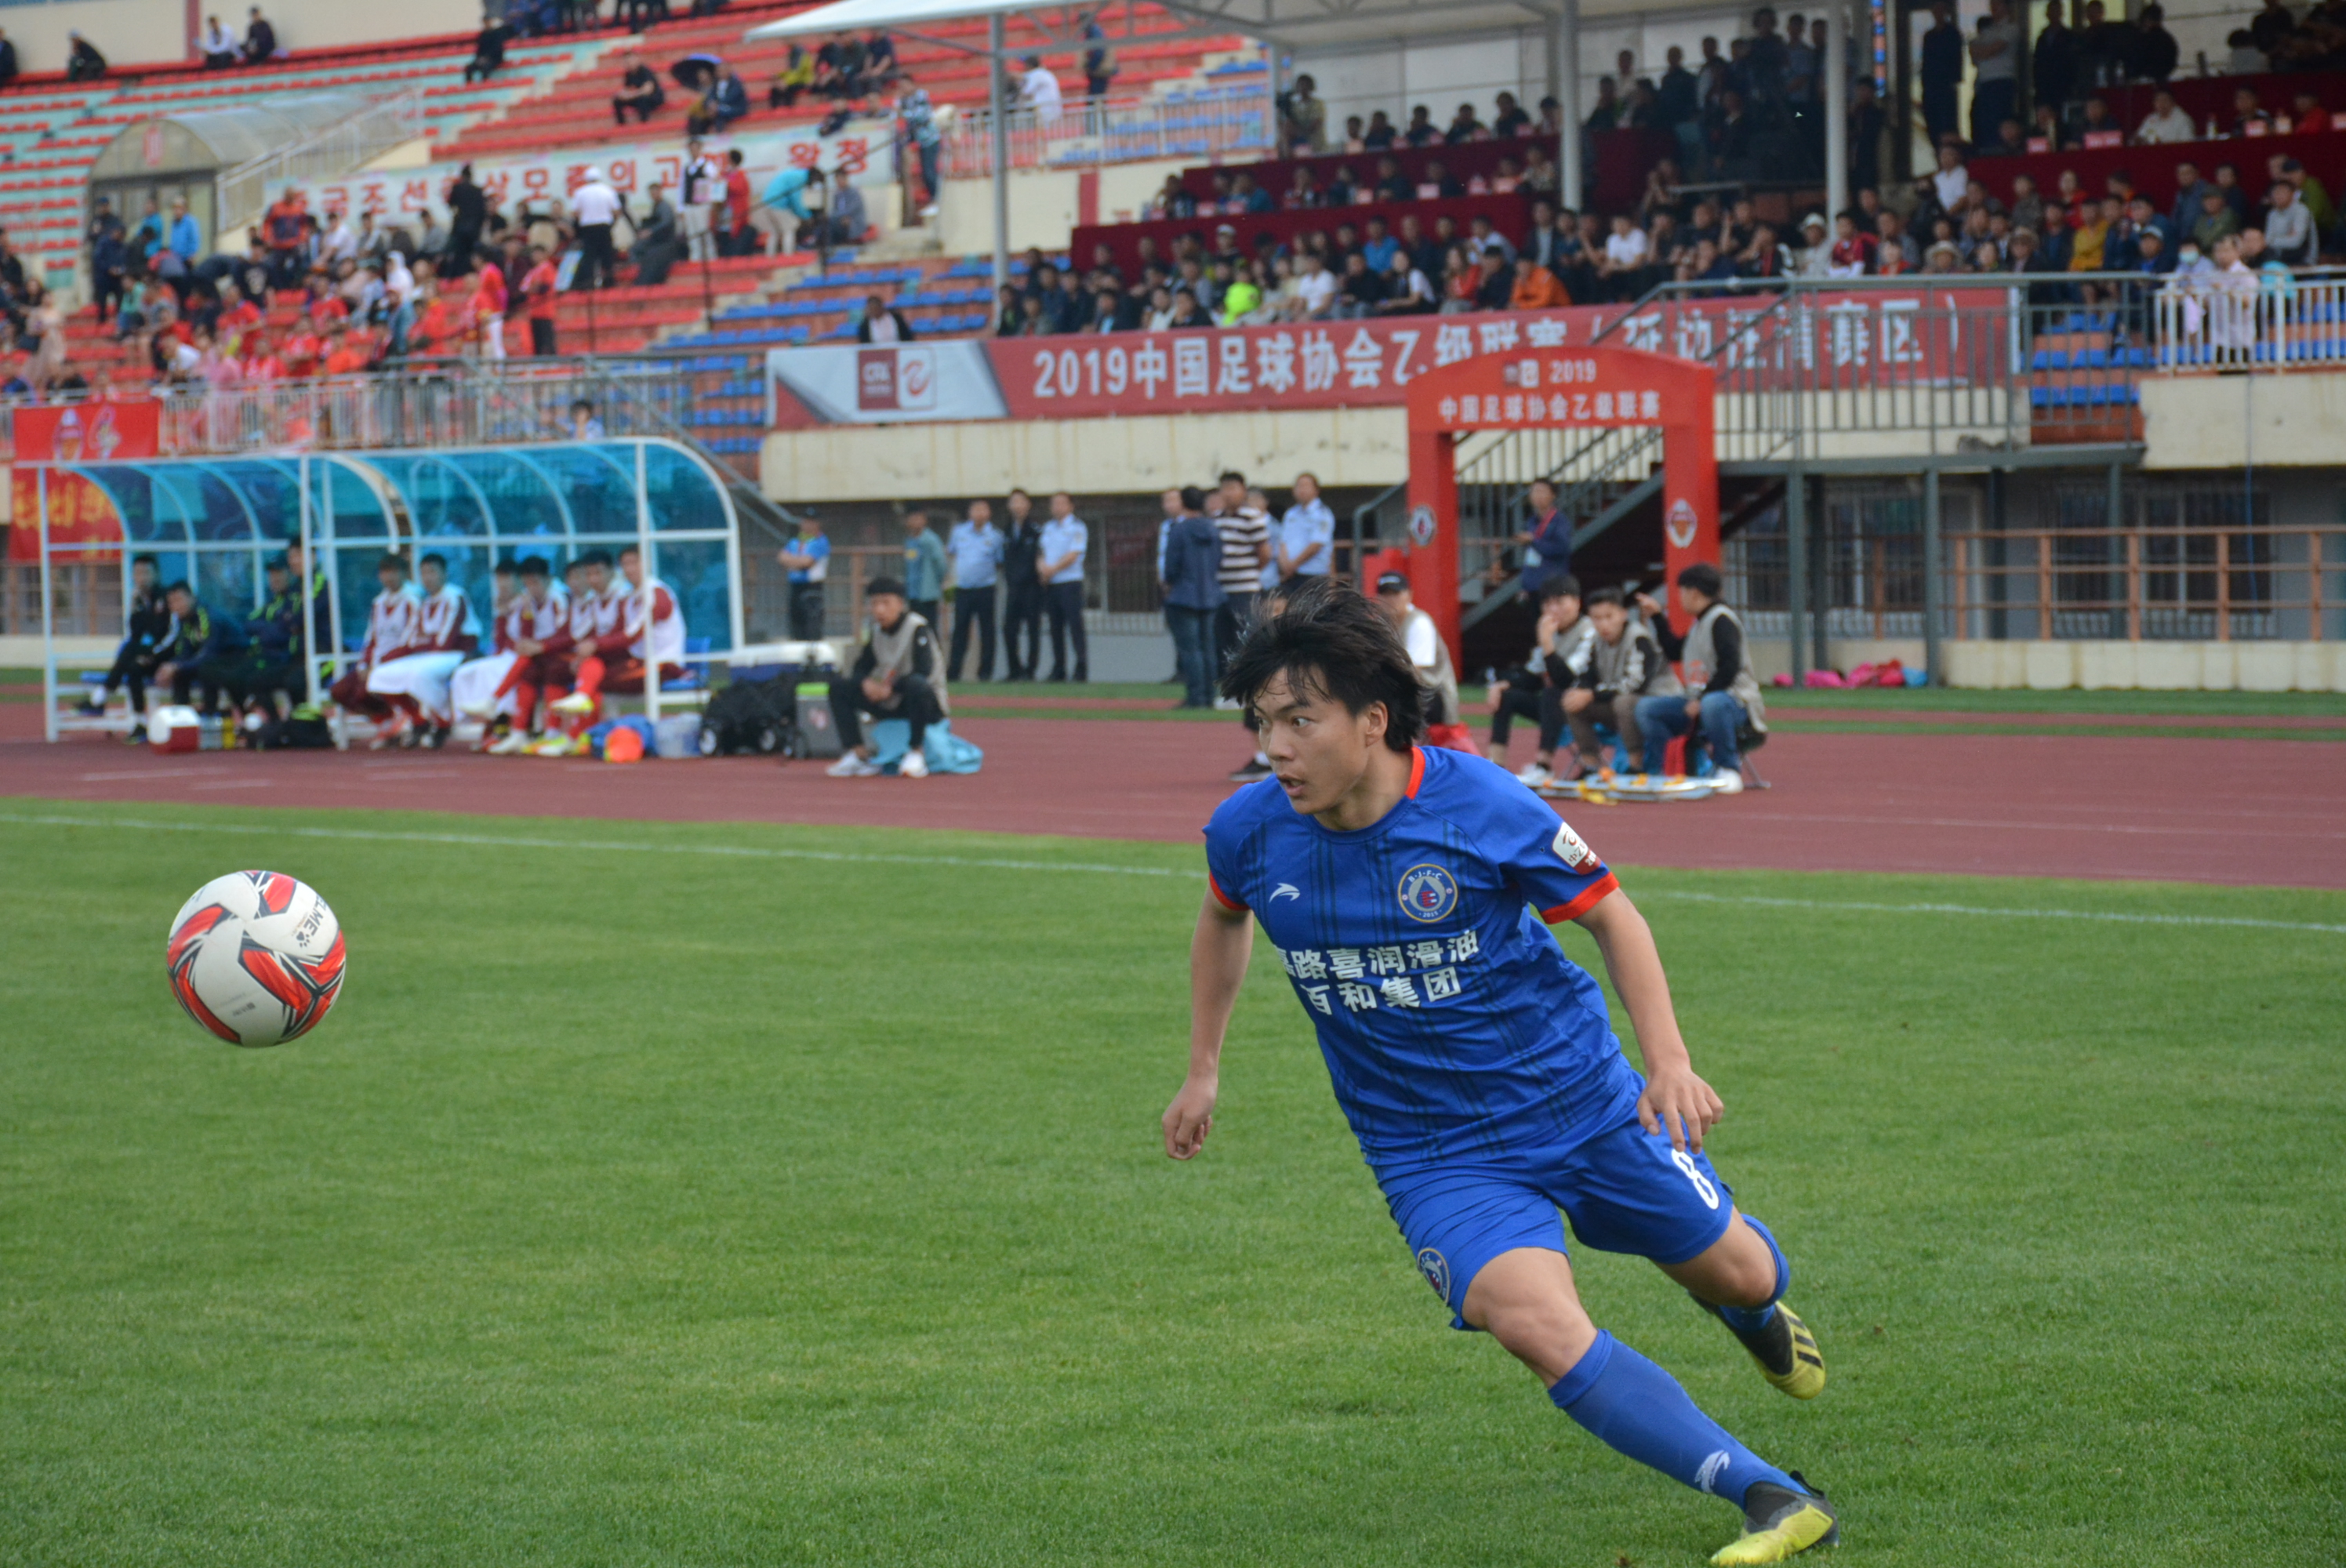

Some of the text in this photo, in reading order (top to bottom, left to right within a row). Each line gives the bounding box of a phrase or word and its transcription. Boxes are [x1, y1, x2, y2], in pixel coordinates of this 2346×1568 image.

[1549, 358, 1597, 384] 2019
[1300, 967, 1462, 1015] 百和集团
[1671, 1148, 1720, 1210] 8
